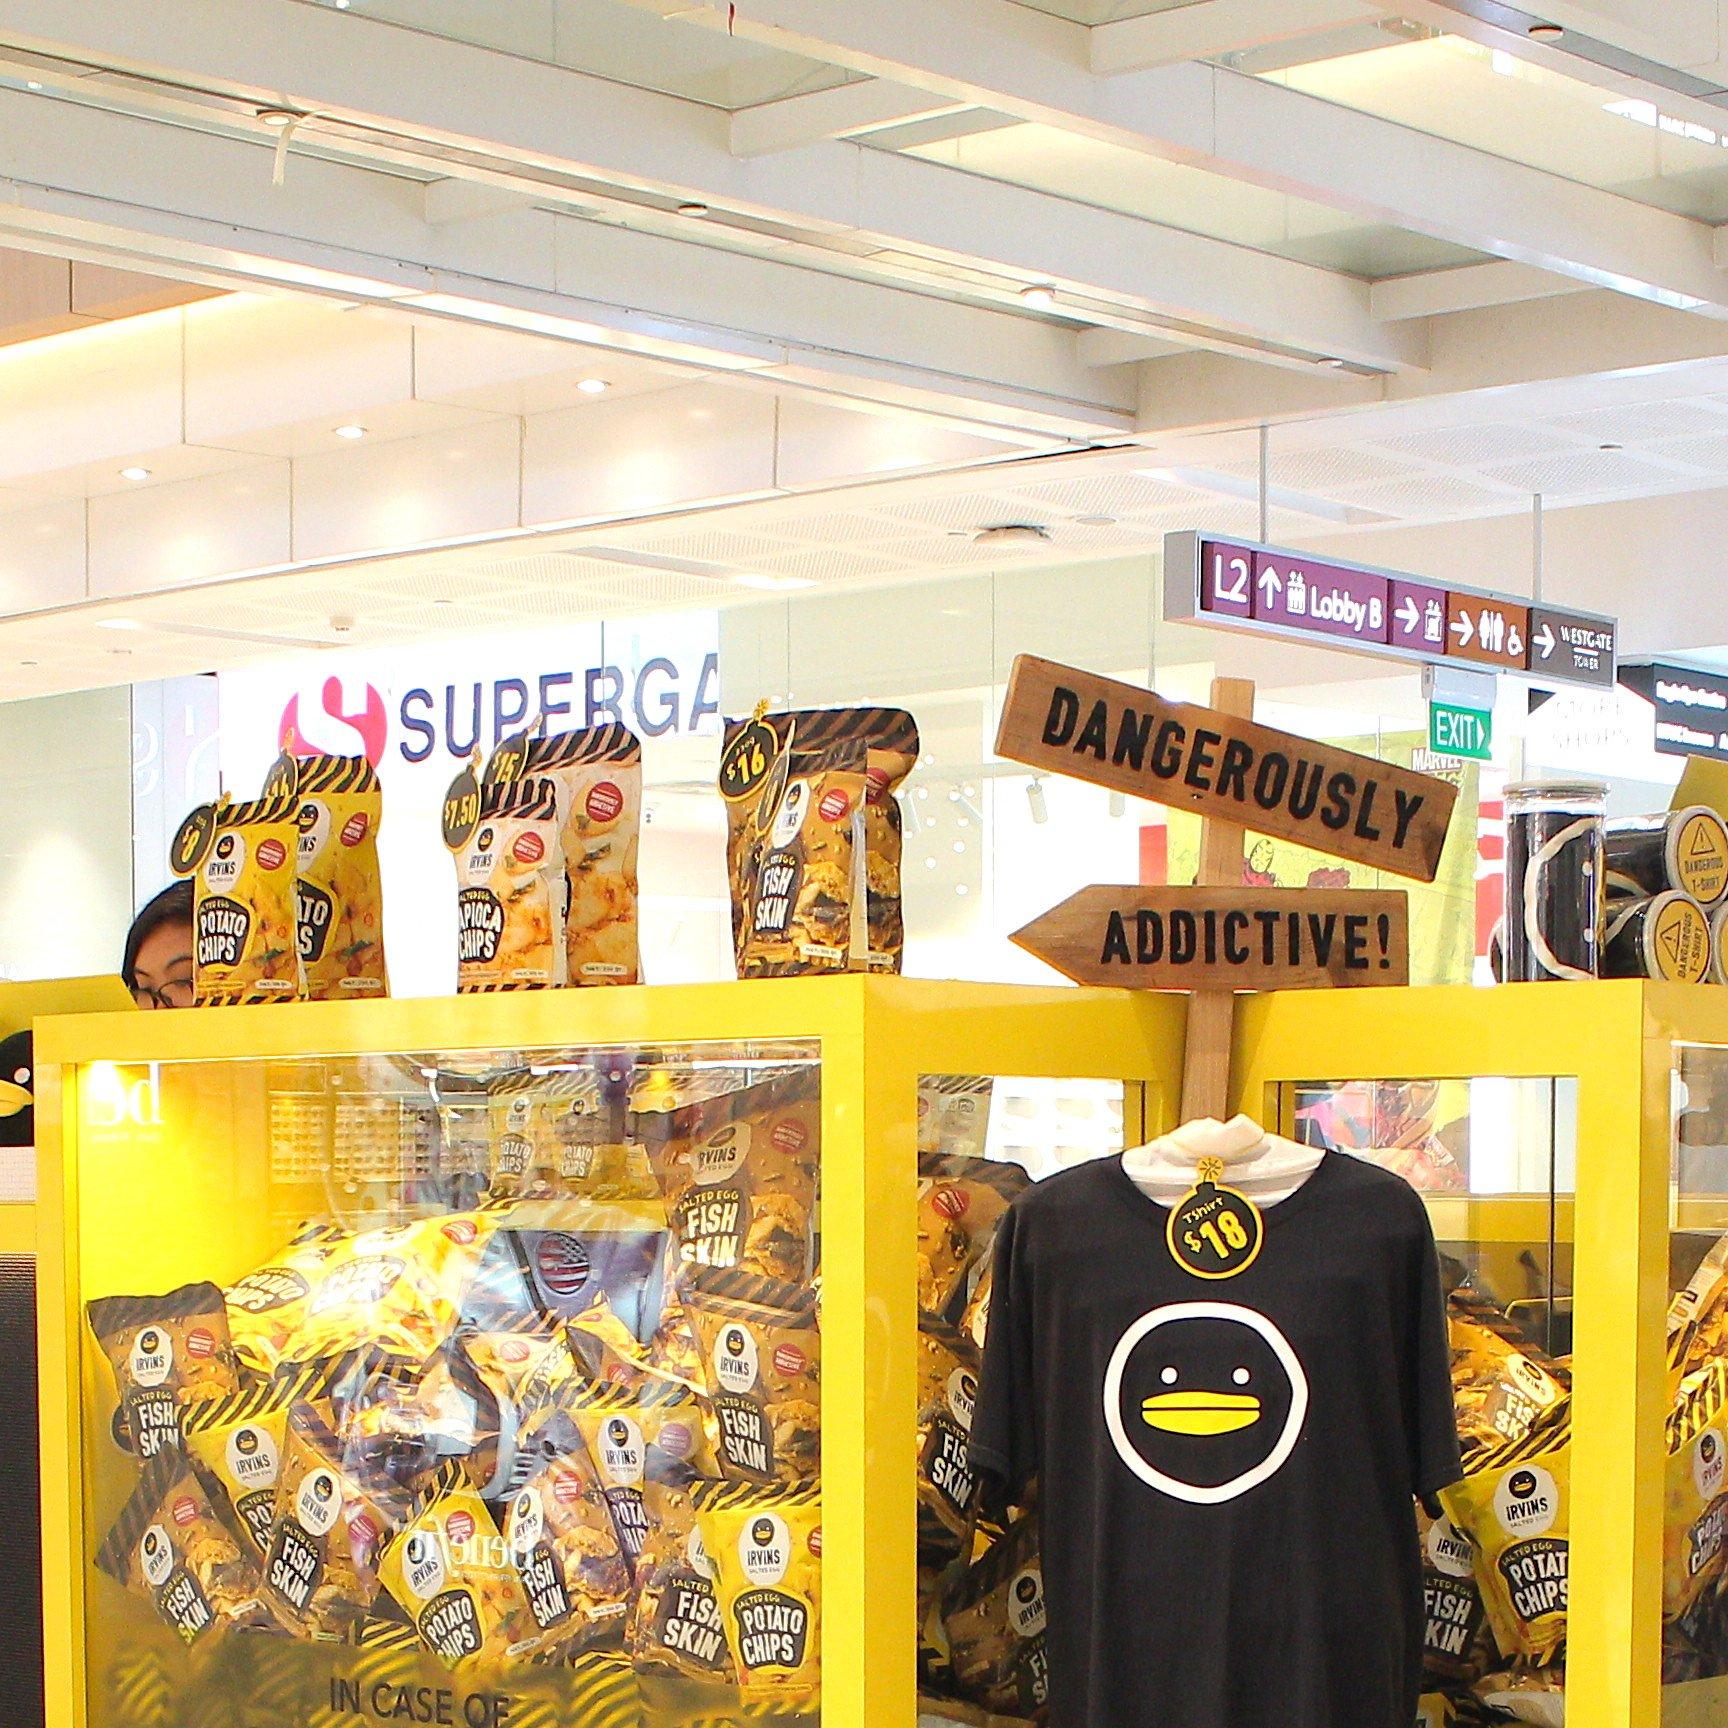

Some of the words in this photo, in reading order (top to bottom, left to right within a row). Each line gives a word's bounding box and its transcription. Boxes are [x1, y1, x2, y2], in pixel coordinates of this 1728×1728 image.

[1214, 554, 1250, 605] L2
[1310, 586, 1367, 632] Lobby
[1368, 596, 1384, 631] B
[1560, 625, 1614, 653] WESTGATE
[1436, 710, 1476, 751] EXIT
[725, 744, 767, 785] $16
[1041, 687, 1425, 850] DANGEROUSLY
[444, 793, 477, 830] $7.50
[762, 867, 795, 898] FISH
[200, 909, 248, 937] POTATO
[755, 897, 790, 931] SKIN
[198, 933, 236, 964] CHIPS
[1100, 909, 1391, 970] ADDICTIVE!
[687, 1201, 740, 1240] FISH
[1183, 1210, 1248, 1259] $18
[679, 1234, 738, 1269] SKIN
[135, 1355, 166, 1373] IRVINS
[720, 1355, 750, 1377] IRVINS
[138, 1400, 175, 1428] FISH
[721, 1407, 762, 1442] FISH
[235, 1453, 272, 1475] IRVINS
[605, 1449, 638, 1466] IRVINS
[723, 1437, 768, 1473] SKIN
[932, 1456, 973, 1508] SKIN
[300, 1492, 329, 1524] IRVINS
[1505, 1496, 1549, 1522] IRVINS
[281, 1536, 317, 1582] FISH
[747, 1548, 781, 1567] IRVINS
[1531, 1541, 1554, 1553] EGG
[271, 1561, 311, 1610] SKIN
[411, 1556, 439, 1588] IRVINS
[523, 1558, 557, 1598] FISH
[672, 1578, 709, 1593] SALTED
[166, 1577, 196, 1621] FISH
[531, 1585, 567, 1630] SKIN
[736, 1595, 763, 1610] SALTED
[763, 1592, 781, 1604] EGG
[1424, 1587, 1472, 1625] FISH
[1513, 1579, 1568, 1619] CHIPS
[176, 1597, 211, 1646] SKIN
[425, 1595, 473, 1645] POTATO
[742, 1603, 804, 1635] POTATO
[663, 1618, 723, 1663] SKIN
[741, 1633, 794, 1665] CHIPS
[329, 1677, 361, 1714] IN
[372, 1682, 454, 1727] CASE
